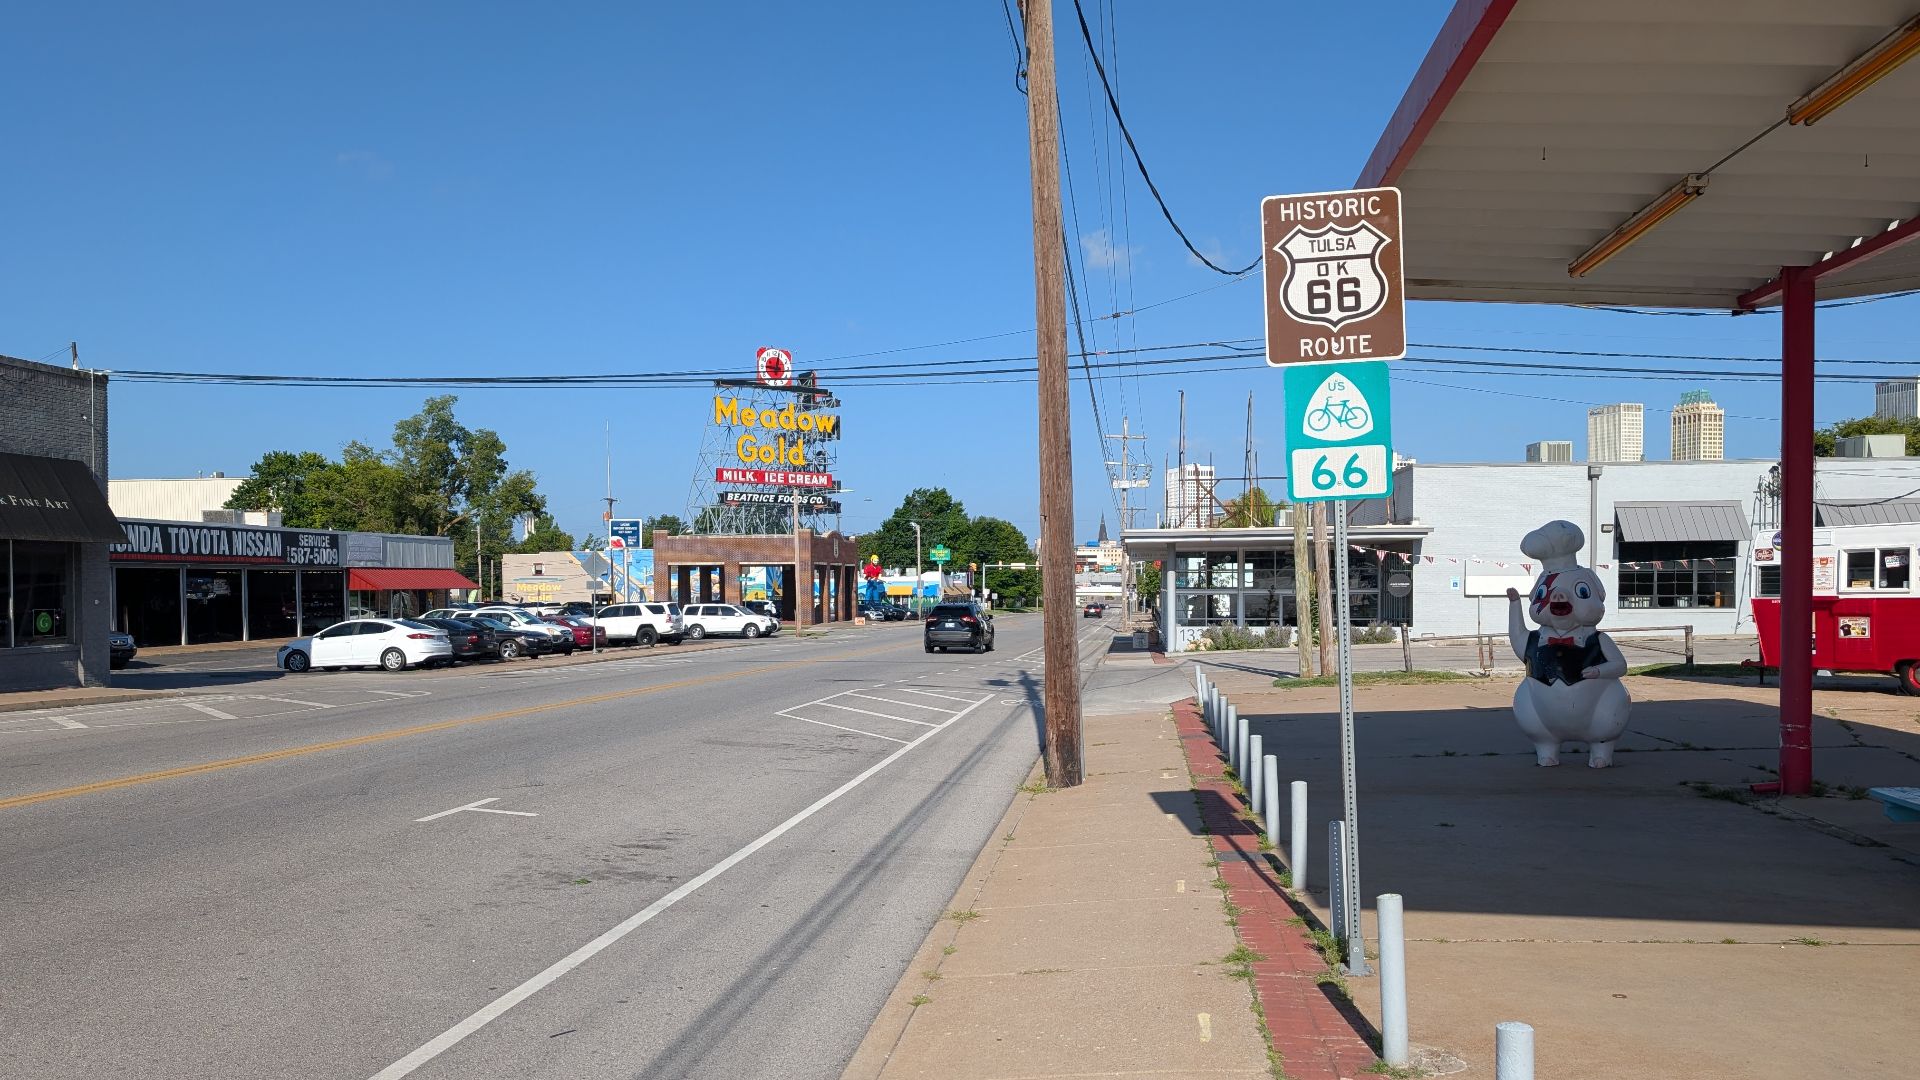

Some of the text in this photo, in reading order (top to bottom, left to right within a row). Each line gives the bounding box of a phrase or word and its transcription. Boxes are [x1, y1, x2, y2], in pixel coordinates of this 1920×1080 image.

[1280, 196, 1381, 222] HISTORIC
[1308, 238, 1357, 254] TULSA
[1306, 276, 1362, 315] 66
[1300, 334, 1373, 358] ROUTE
[1328, 380, 1346, 392] US
[714, 395, 835, 432] Meadow
[736, 433, 806, 466] Gold
[764, 472, 785, 483] ICE
[788, 473, 828, 485] CREAM
[1311, 453, 1369, 491] 66
[727, 492, 825, 505] BEATRICE FOODS CO.
[167, 527, 230, 555] TOYOTA
[232, 530, 282, 557] NISSAN
[298, 534, 331, 548] SERVICE
[290, 547, 339, 565] 587-5009
